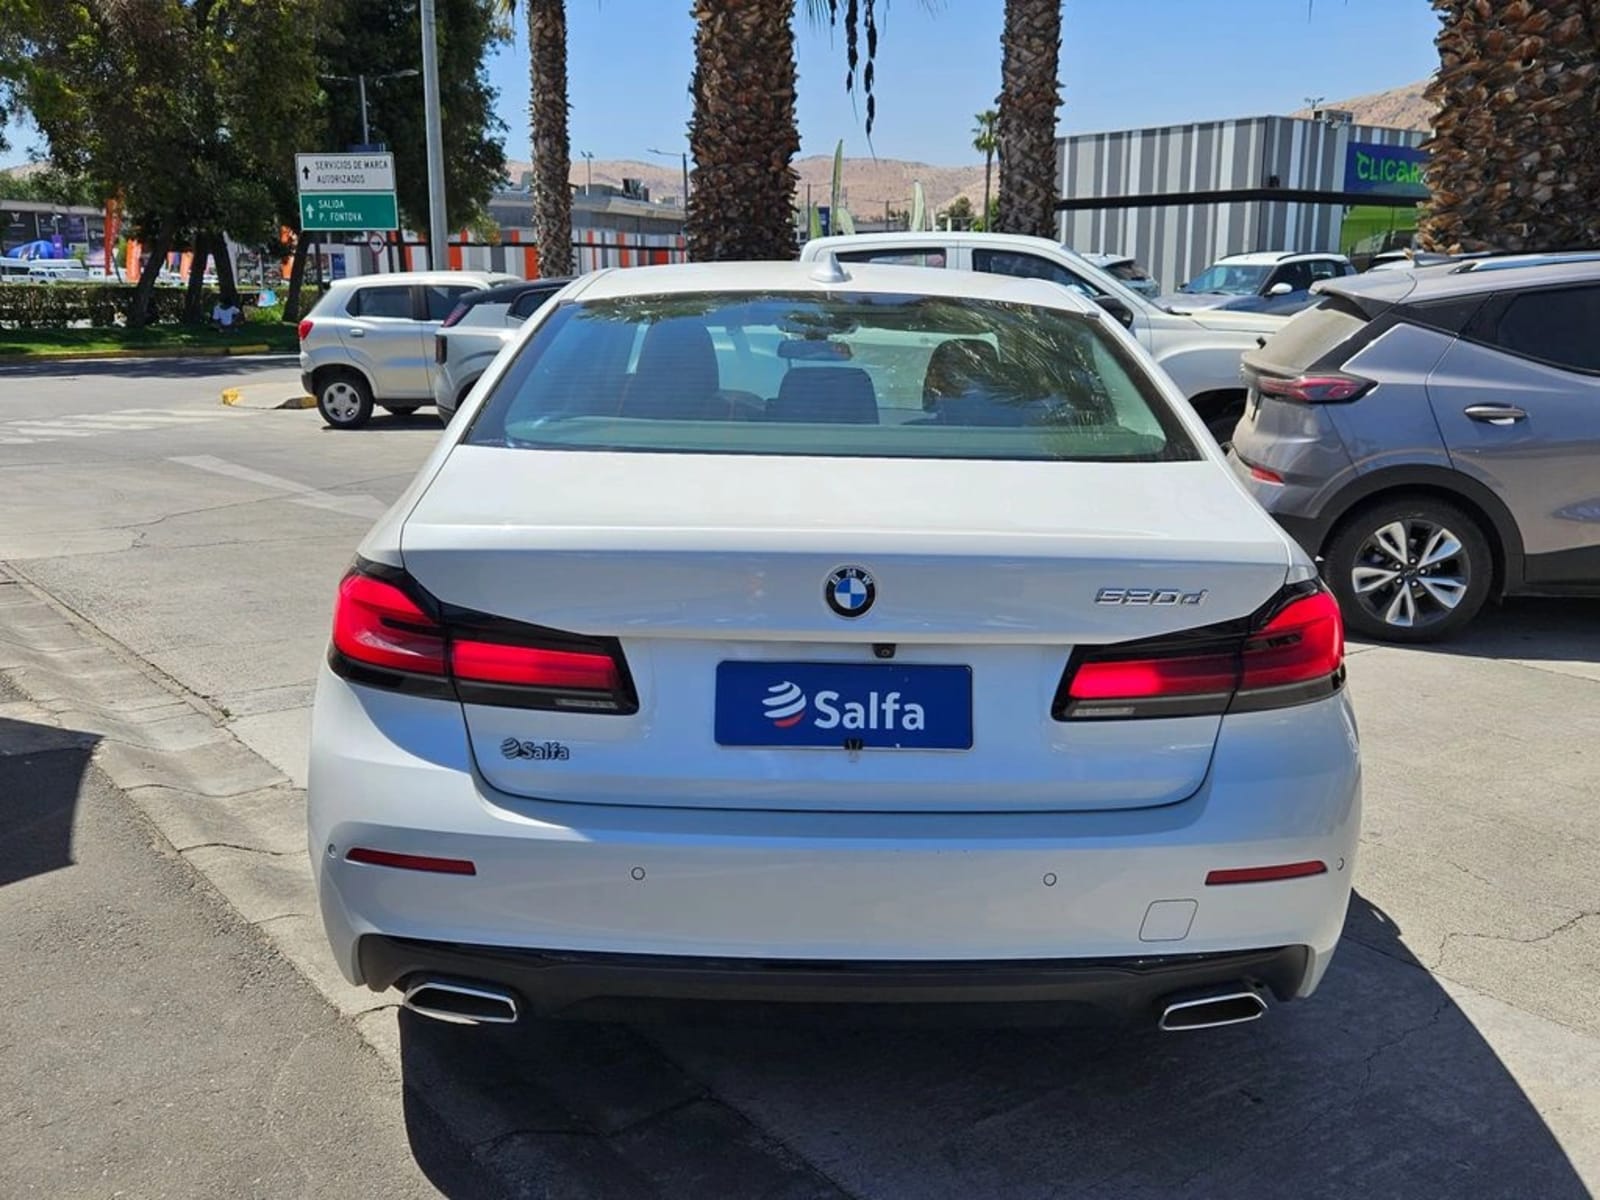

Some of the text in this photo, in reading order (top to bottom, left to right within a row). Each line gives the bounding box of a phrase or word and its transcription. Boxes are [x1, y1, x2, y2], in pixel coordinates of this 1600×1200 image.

[315, 160, 388, 170] SERVICIOS DE MARCA
[317, 174, 365, 184] AUTORIZADOS
[318, 199, 345, 209] SALIDA
[319, 212, 363, 221] P. FONTOVA
[830, 569, 873, 585] BMW
[1095, 588, 1209, 605] 520d
[814, 690, 925, 731] Salfa
[520, 741, 570, 760] Salfa
